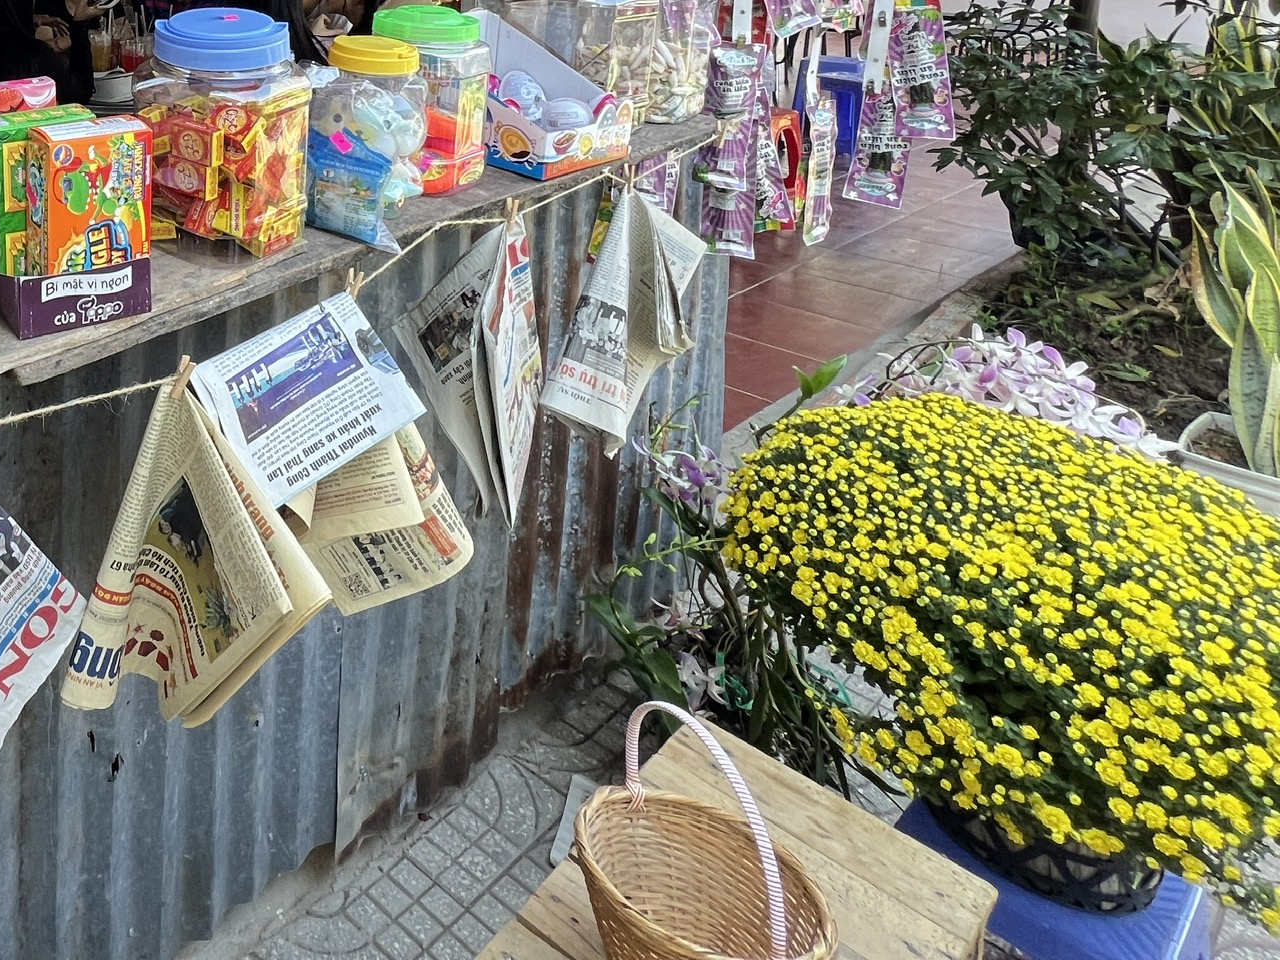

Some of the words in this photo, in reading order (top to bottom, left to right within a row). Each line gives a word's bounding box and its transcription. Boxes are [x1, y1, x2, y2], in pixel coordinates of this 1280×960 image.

[45, 281, 57, 296] Bí
[62, 279, 82, 292] mật
[87, 278, 97, 291] vị
[100, 273, 128, 289] ngon
[53, 310, 76, 325] của
[358, 401, 384, 424] xuất
[323, 430, 338, 444] xe
[334, 415, 362, 438] khẩu
[300, 436, 326, 459] sang
[336, 422, 377, 454] Hyundai
[280, 452, 305, 473] Thái
[307, 446, 341, 473] Thành
[264, 465, 285, 484] Lan
[284, 465, 311, 488] Công
[20, 553, 34, 570] USD
[108, 557, 124, 573] 67
[0, 576, 14, 593] năm
[82, 678, 95, 687] AN
